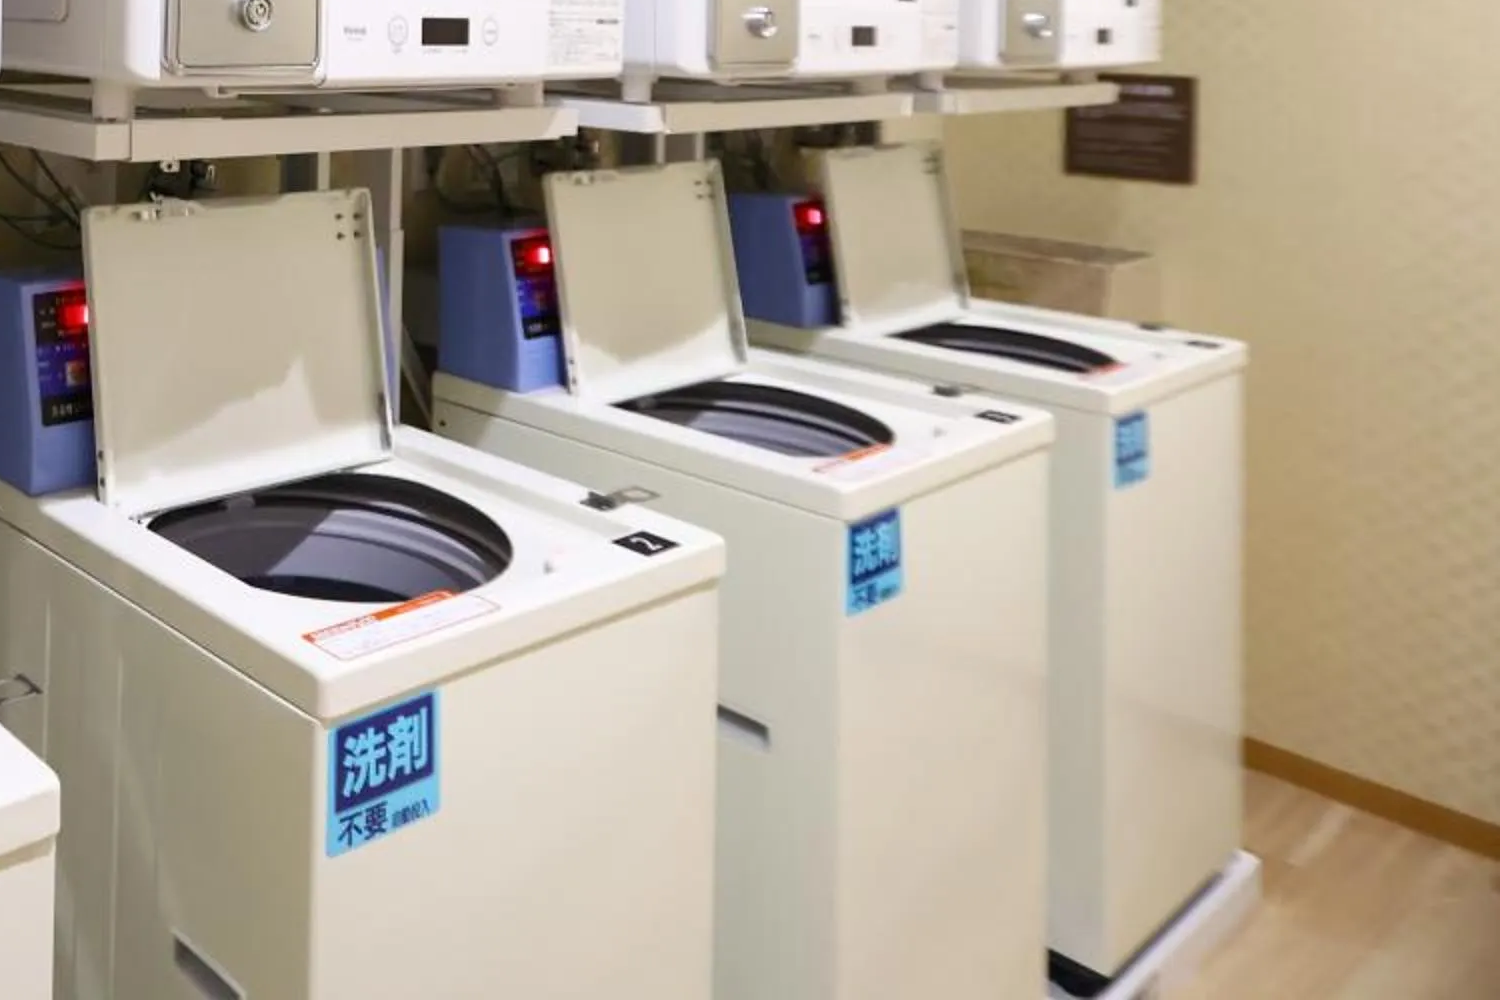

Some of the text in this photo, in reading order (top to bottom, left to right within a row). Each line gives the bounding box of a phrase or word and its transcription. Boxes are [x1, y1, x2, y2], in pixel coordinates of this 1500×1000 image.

[629, 537, 664, 551] 2
[342, 706, 428, 798] 洗剤
[338, 800, 389, 848] 不要
